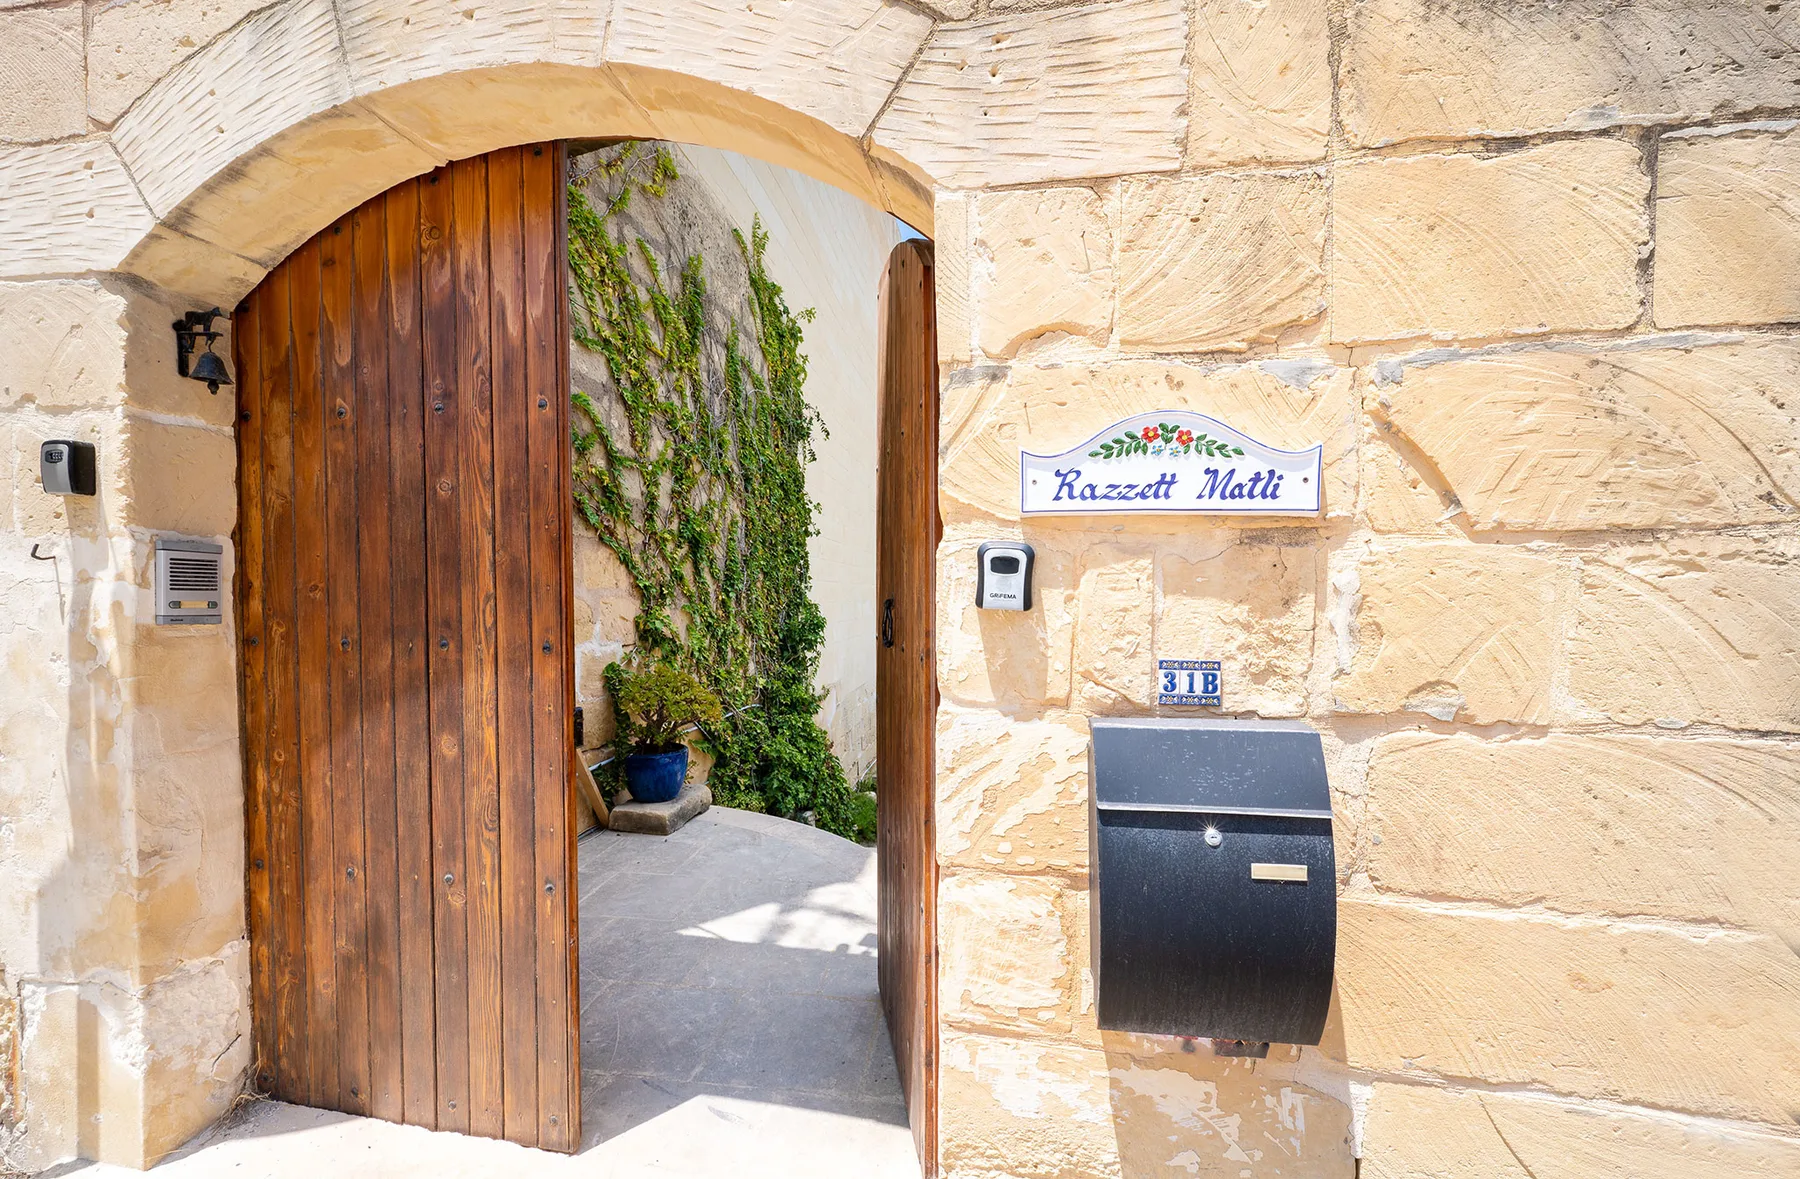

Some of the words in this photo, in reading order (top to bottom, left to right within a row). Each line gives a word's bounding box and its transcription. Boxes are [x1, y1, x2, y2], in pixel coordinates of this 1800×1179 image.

[1052, 468, 1179, 501] Razzett
[1196, 467, 1284, 500] Matli
[1163, 671, 1218, 694] 31B
